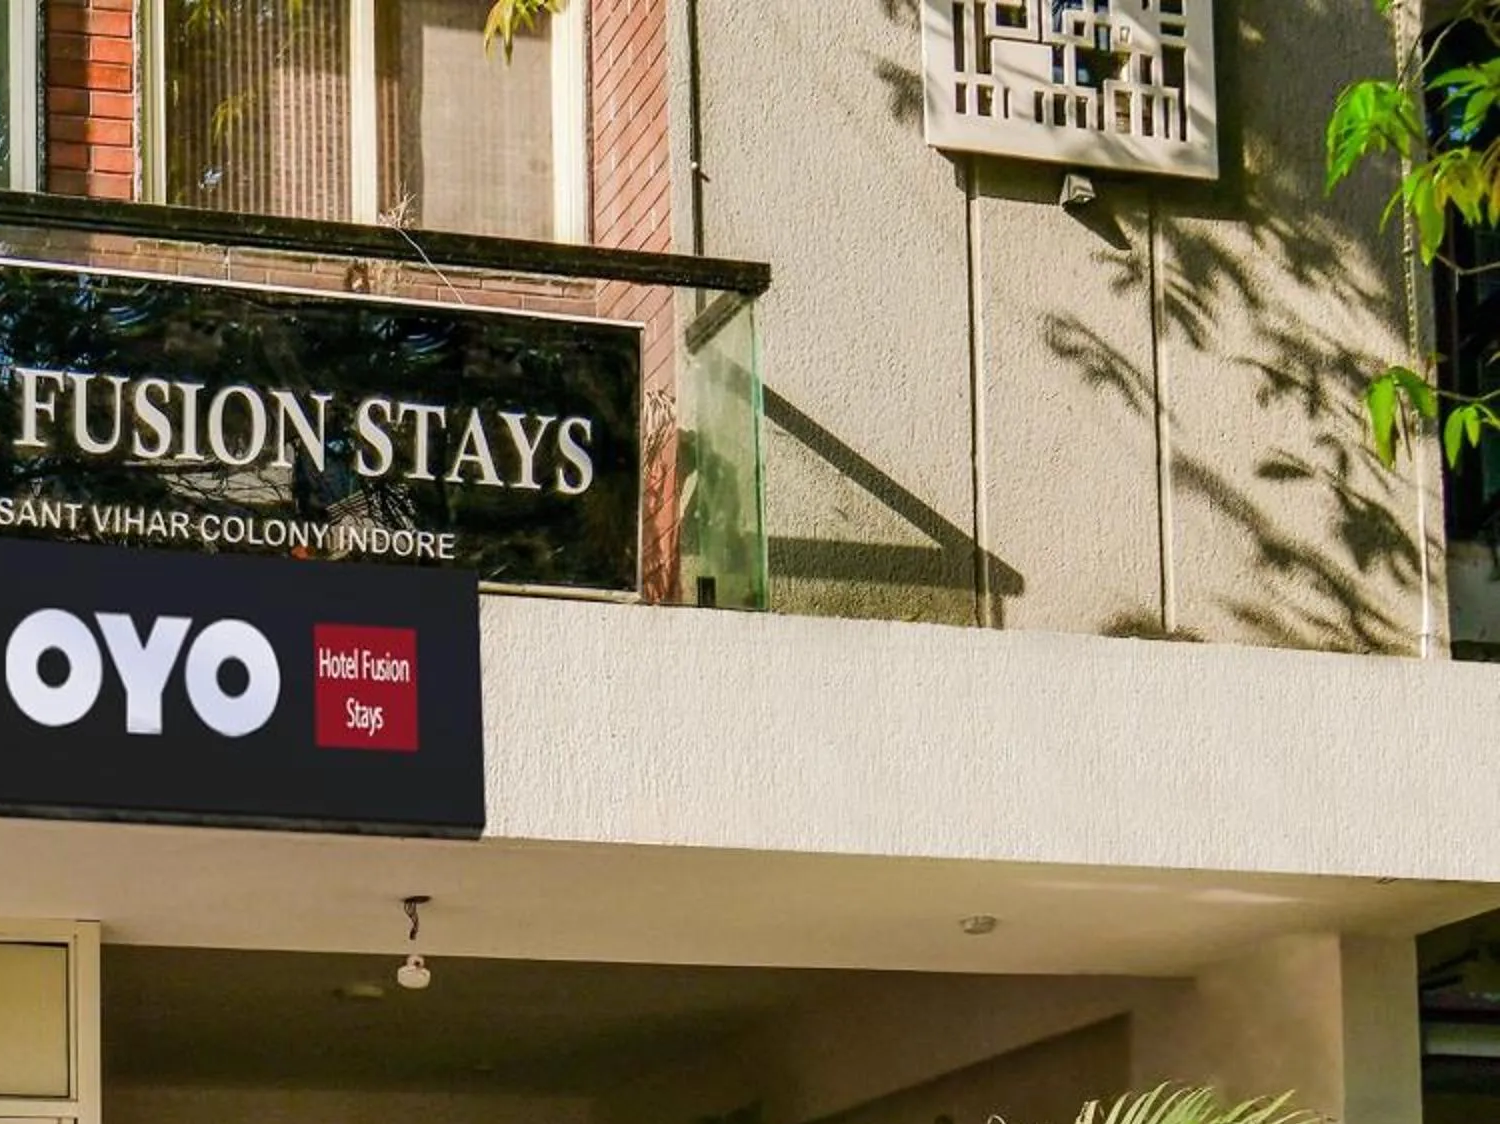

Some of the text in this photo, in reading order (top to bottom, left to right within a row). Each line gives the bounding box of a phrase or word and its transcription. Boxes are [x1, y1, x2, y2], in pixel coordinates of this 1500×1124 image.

[12, 366, 332, 474] FUSION
[354, 398, 596, 496] STAYS
[91, 503, 190, 539] VIHAR
[200, 513, 331, 549] COLONY
[337, 524, 456, 560] INDORE
[5, 607, 281, 737] OYO
[318, 647, 410, 684] Hotel Fusion
[345, 697, 384, 733] Stays
